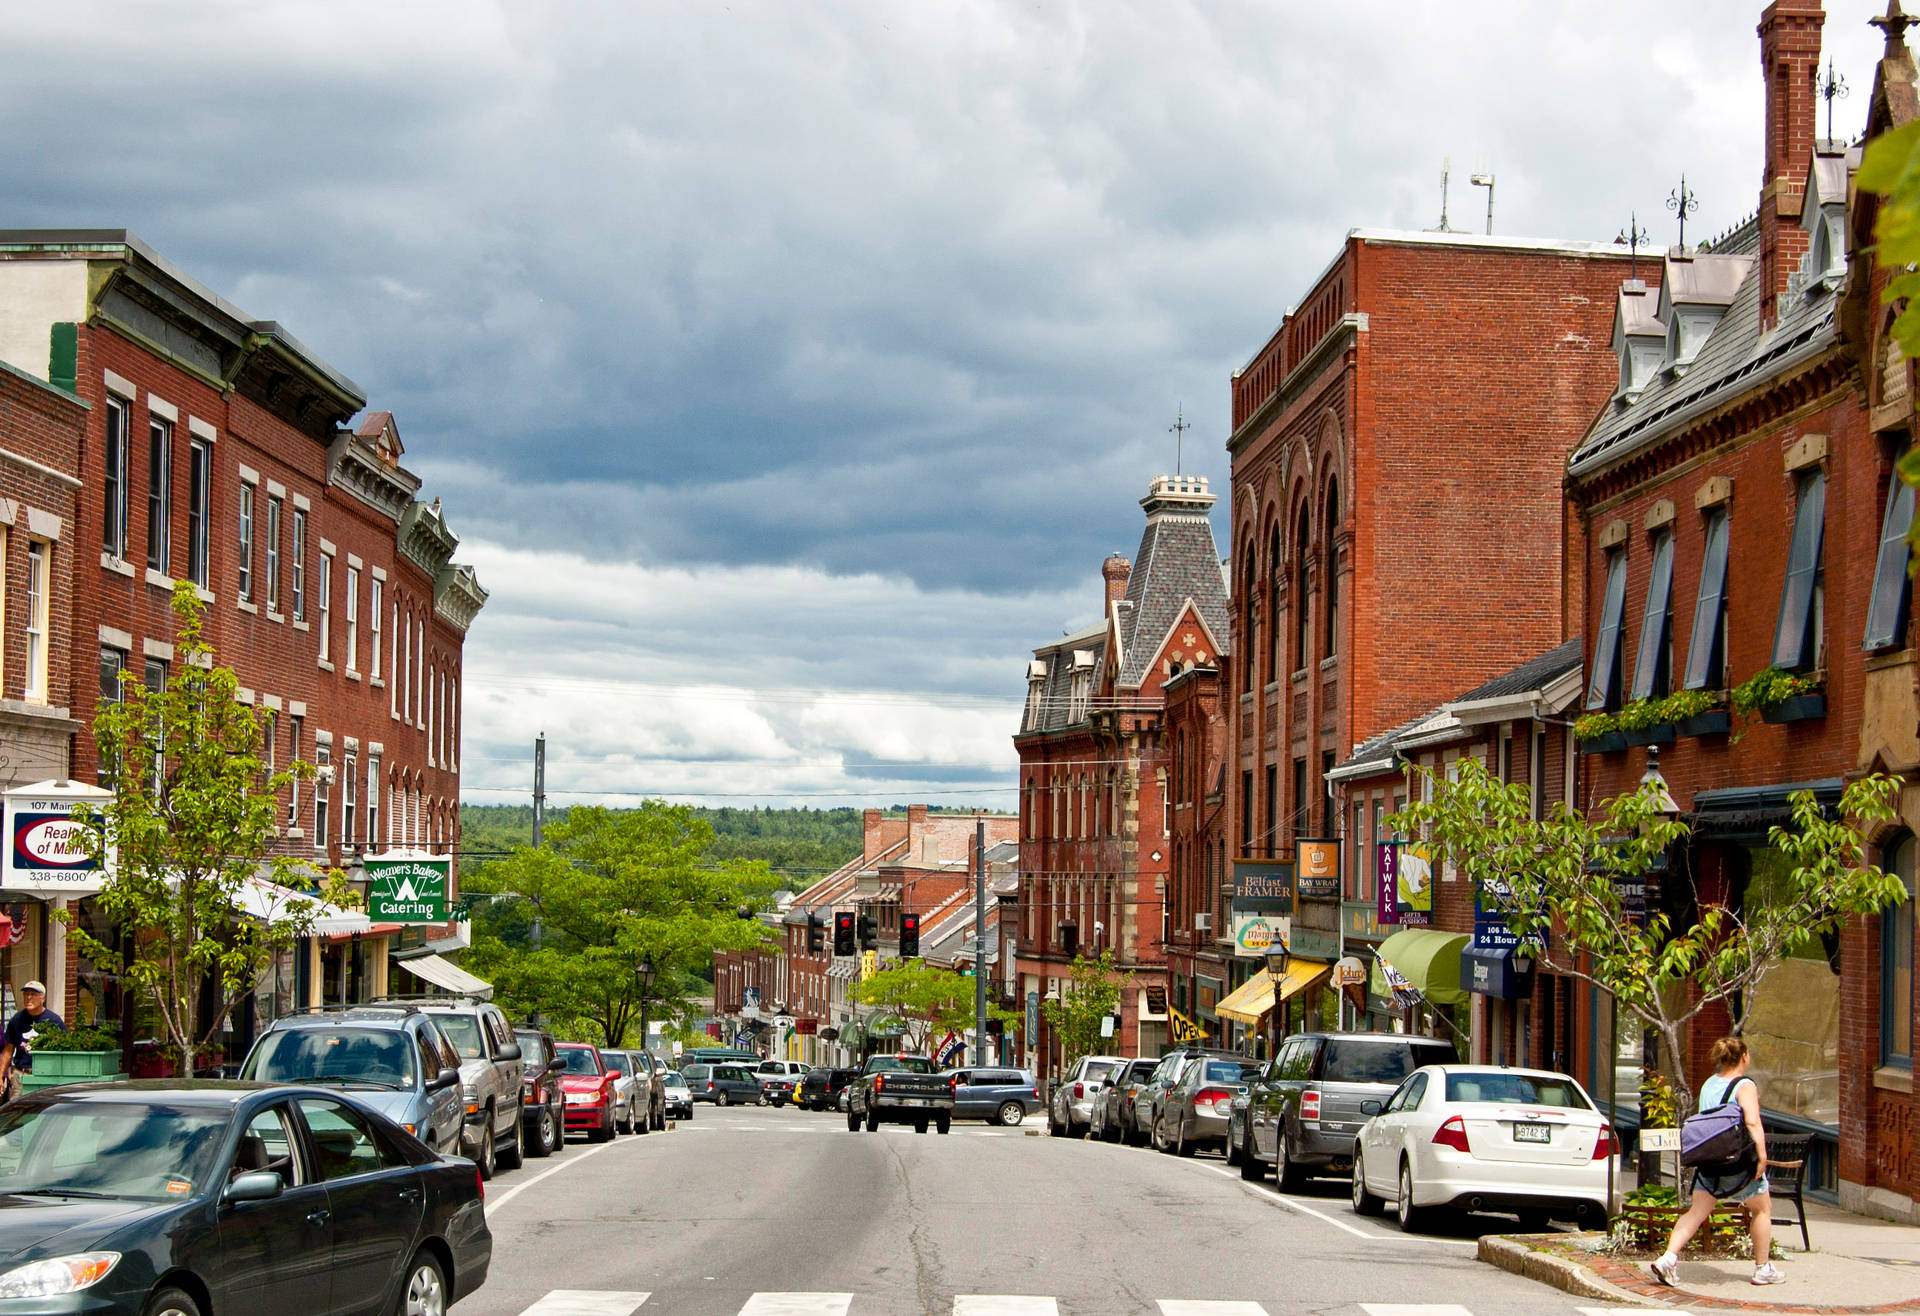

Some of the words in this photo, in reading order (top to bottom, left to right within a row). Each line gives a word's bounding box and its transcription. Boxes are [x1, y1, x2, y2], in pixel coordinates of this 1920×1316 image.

[30, 801, 47, 810] 107
[50, 801, 73, 811] Main
[37, 842, 51, 855] of
[30, 871, 87, 882] 338-6800
[370, 864, 411, 881] Weaver's
[412, 863, 444, 884] Bakery
[1383, 844, 1392, 912] KATWALK
[1245, 876, 1282, 887] Belfast
[1299, 878, 1315, 887] BAY
[1316, 879, 1338, 887] WRAP
[1237, 886, 1291, 897] FRAMER
[380, 901, 434, 920] Catering
[1255, 921, 1267, 930] Yo
[1399, 917, 1428, 925] FASHION
[1480, 935, 1491, 944] 24
[1493, 935, 1518, 944] Hour
[1334, 965, 1366, 985] John's
[1173, 1014, 1200, 1040] OPEN
[885, 1083, 945, 1091] CHEVROLET
[1520, 1127, 1539, 1137] 9742
